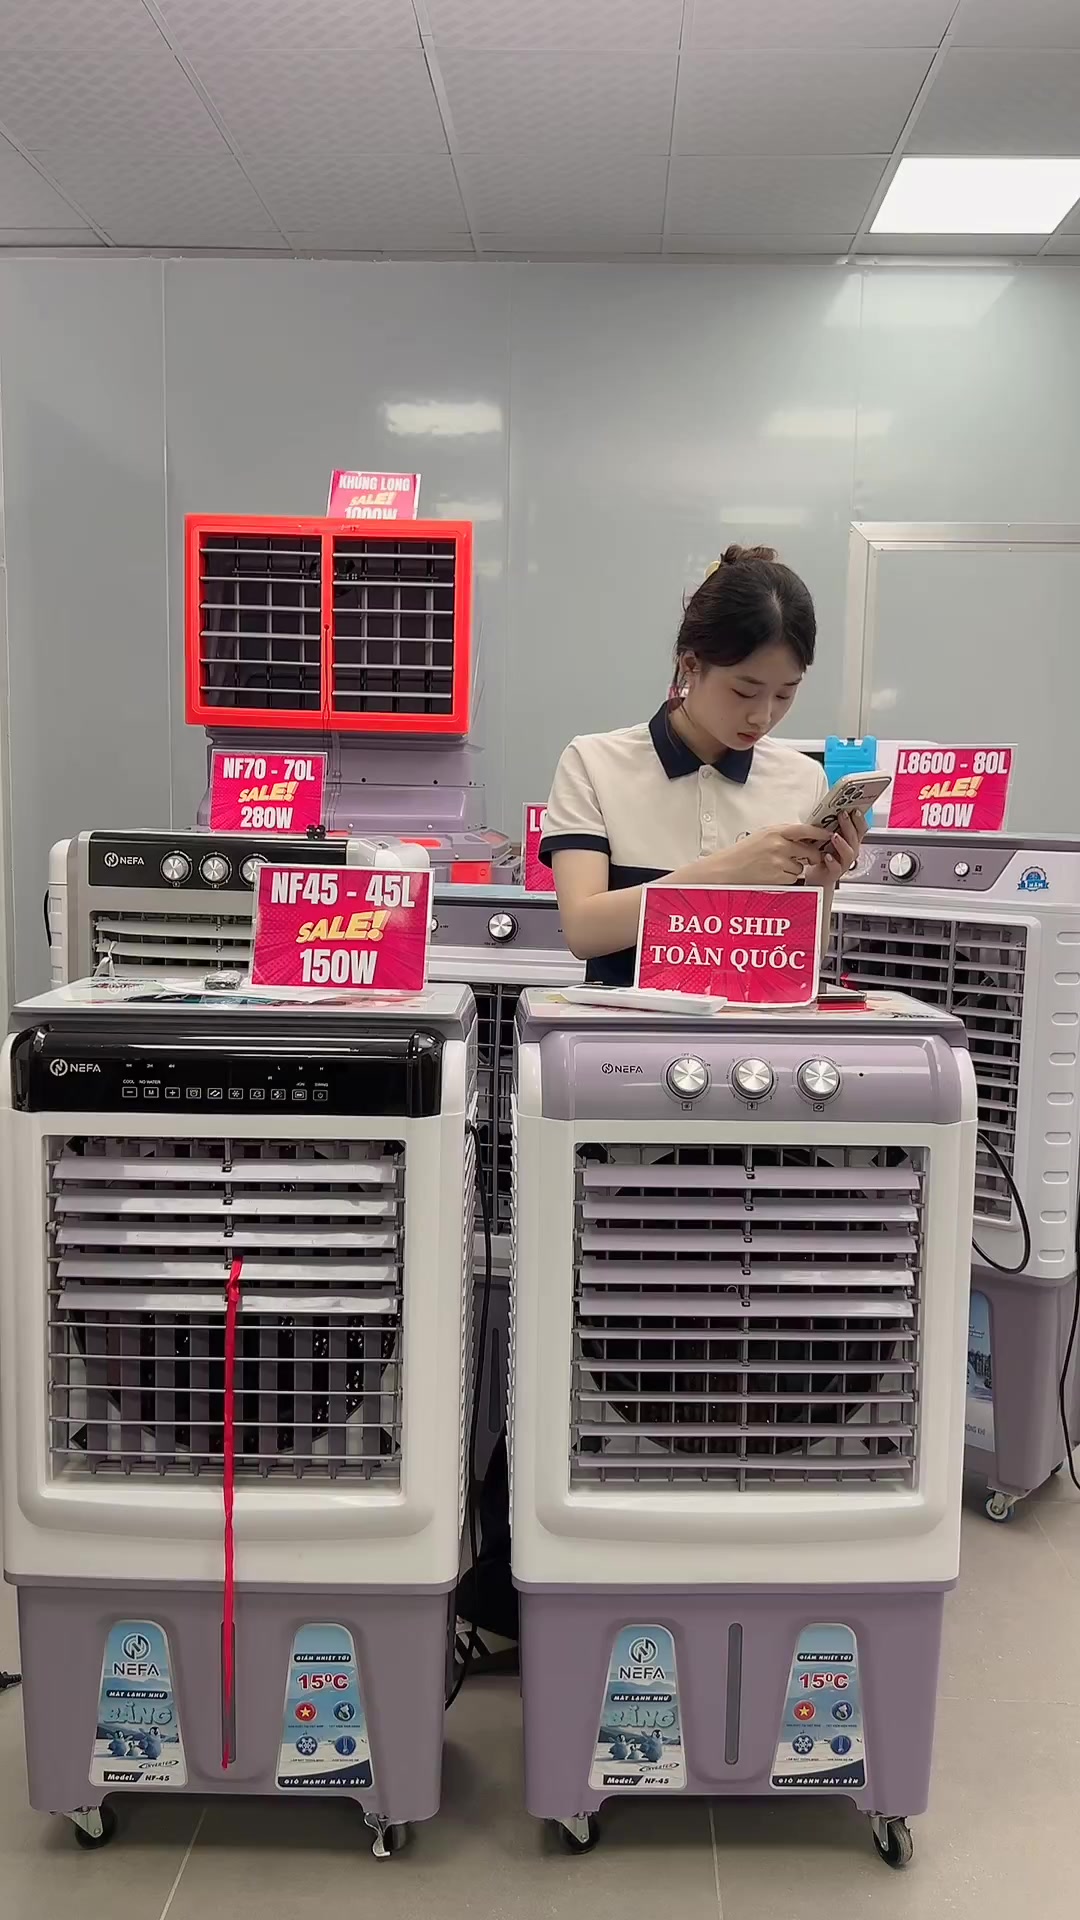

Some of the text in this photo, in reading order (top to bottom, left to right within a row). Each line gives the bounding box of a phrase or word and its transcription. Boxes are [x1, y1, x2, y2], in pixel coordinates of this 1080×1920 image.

[380, 478, 411, 492] LONG
[348, 492, 398, 506] SALE!
[223, 757, 267, 779] NF70
[284, 759, 315, 781] 70L
[897, 751, 956, 774] L8600
[973, 751, 1008, 774] 80L
[238, 781, 299, 803] SALE!
[918, 775, 984, 800] SALE!
[240, 806, 293, 829] 280W
[920, 803, 974, 828] 180W
[119, 858, 145, 866] NEFA
[270, 871, 339, 905] NF45
[365, 874, 415, 908] 45L
[296, 910, 391, 943] SALE!
[667, 914, 791, 937] BAO SHIP
[300, 949, 378, 985] 150W
[650, 942, 806, 973] TOÀN QUỐC
[69, 1063, 101, 1073] NEFA
[614, 1065, 644, 1073] NEFA
[113, 1663, 160, 1677] NEFA
[619, 1667, 666, 1680] NEFA
[145, 1774, 170, 1782] NF-45
[644, 1777, 669, 1785] NF-45
